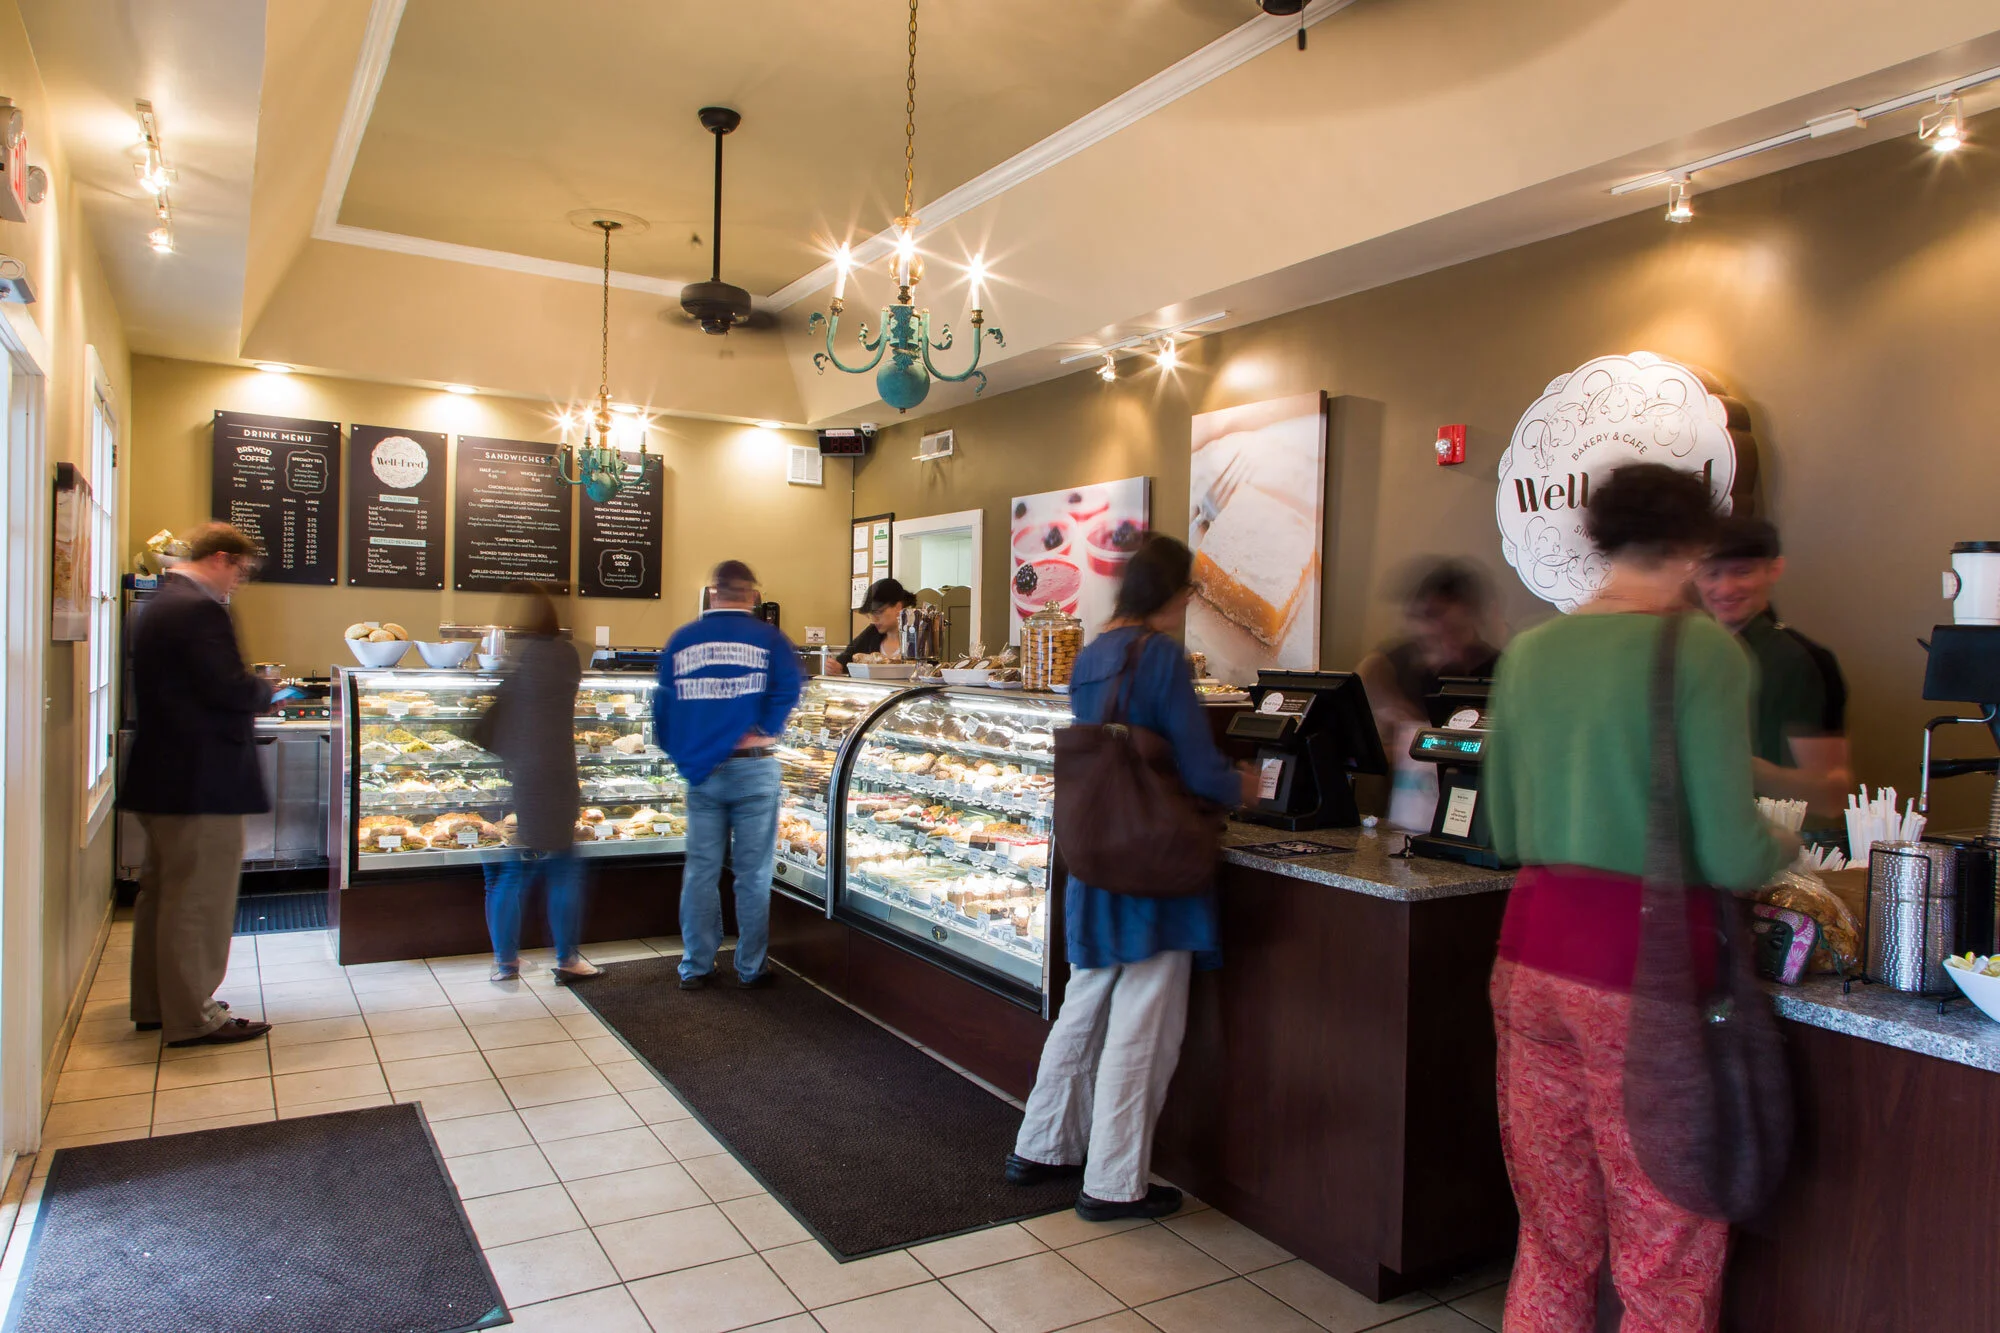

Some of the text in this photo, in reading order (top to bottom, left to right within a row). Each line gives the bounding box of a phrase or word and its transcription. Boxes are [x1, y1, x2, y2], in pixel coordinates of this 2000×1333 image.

[244, 429, 311, 443] DRINK MENU
[236, 444, 272, 456] BREWED
[1571, 432, 1648, 461] BAKERY & CAFE
[240, 454, 269, 463] COFFEE
[485, 452, 546, 464] SANDWICHES
